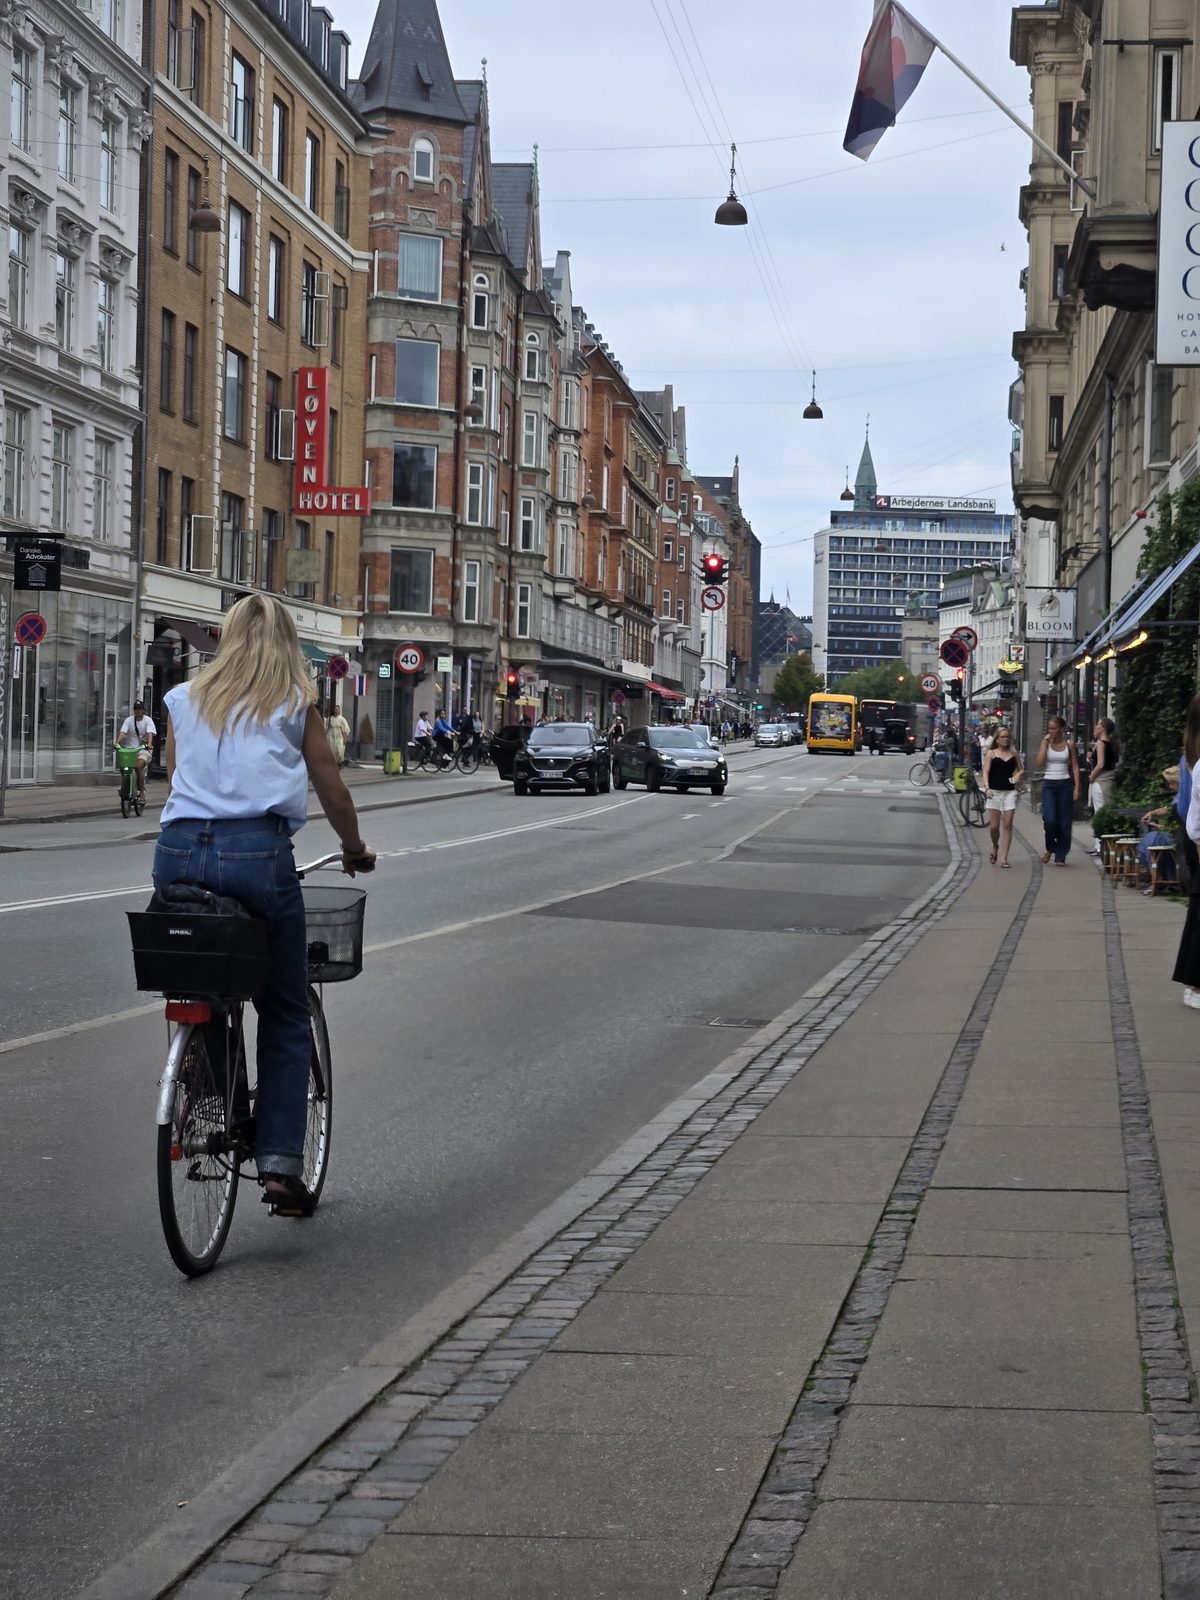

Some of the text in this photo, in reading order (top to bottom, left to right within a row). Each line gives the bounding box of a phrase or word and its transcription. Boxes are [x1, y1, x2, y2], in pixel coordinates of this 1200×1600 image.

[303, 371, 319, 483] LØVEN
[299, 491, 366, 511] HOTEL
[891, 496, 994, 509] Arbejdernes Landsbank
[1027, 621, 1072, 631] BLOOM
[401, 654, 418, 664] 40
[923, 680, 936, 688] 40
